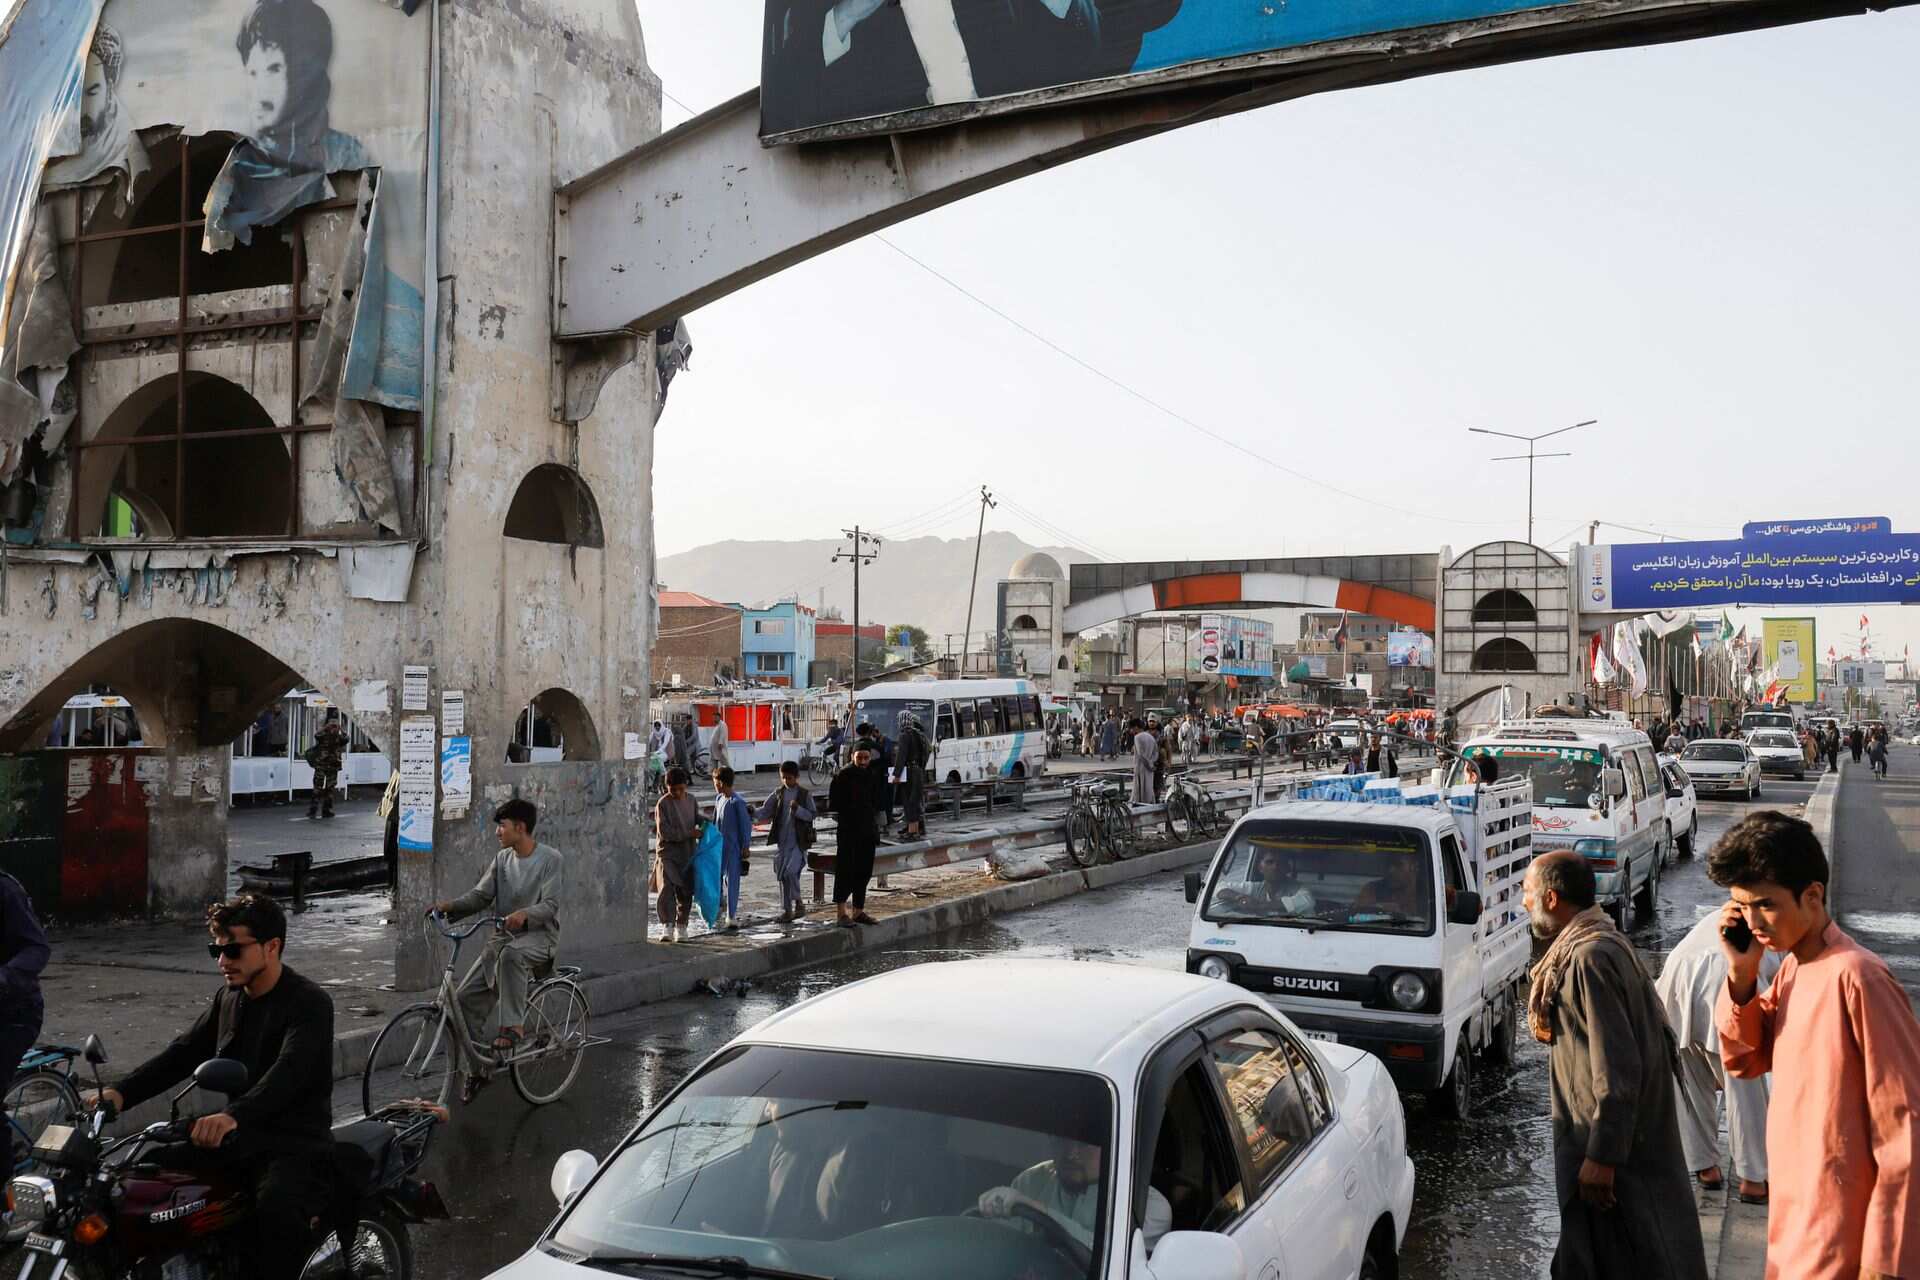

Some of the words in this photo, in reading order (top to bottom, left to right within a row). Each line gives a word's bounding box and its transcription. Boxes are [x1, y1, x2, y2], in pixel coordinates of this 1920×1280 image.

[1632, 555, 1677, 571] انگلیسی
[1677, 555, 1700, 569] زبان
[1701, 552, 1741, 569] آموزش
[1792, 553, 1838, 566] سیستم
[1691, 577, 1725, 591] محقق
[1725, 575, 1733, 590] را
[1734, 573, 1748, 589] آن
[1748, 575, 1760, 586] ما
[1785, 573, 1805, 588] رویا
[1806, 574, 1824, 587] یک
[1889, 574, 1903, 586] در
[1272, 975, 1340, 992] SUZUKI
